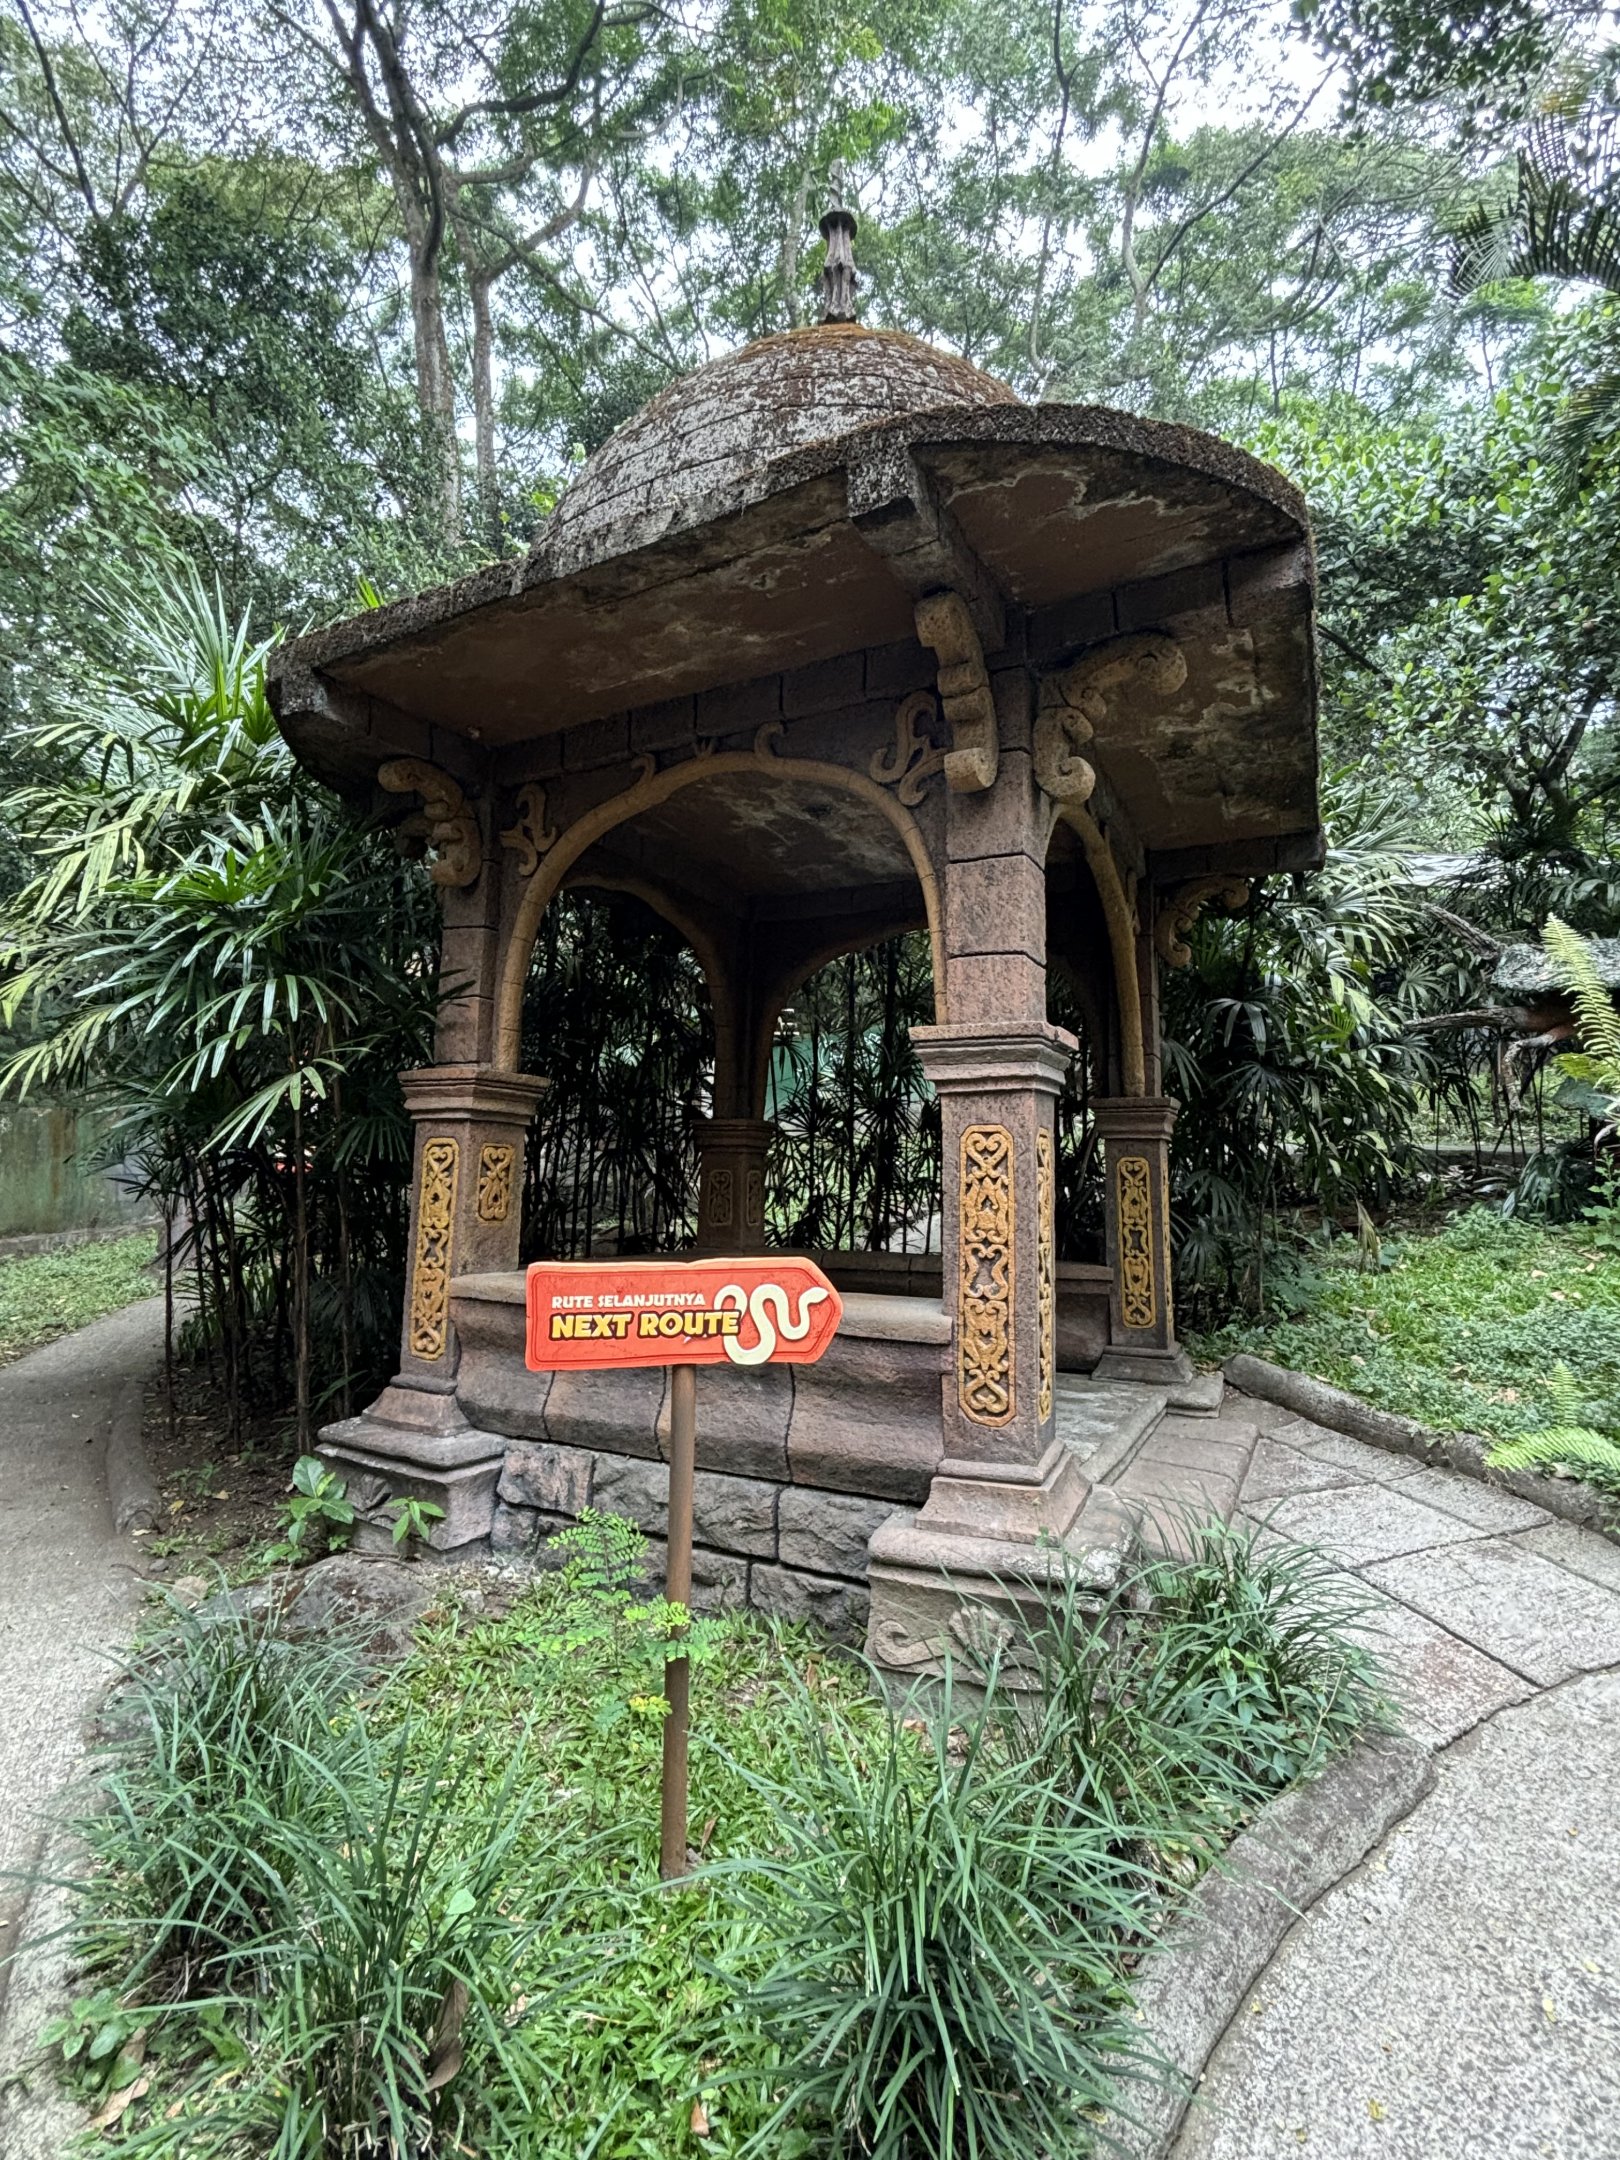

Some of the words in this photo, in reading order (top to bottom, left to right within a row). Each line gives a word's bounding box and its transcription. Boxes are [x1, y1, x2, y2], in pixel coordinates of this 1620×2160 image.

[552, 1295, 593, 1309] RUTE
[598, 1294, 705, 1308] SELANJUTNYA
[551, 1312, 632, 1339] NEXT
[639, 1310, 740, 1337] ROUTE
